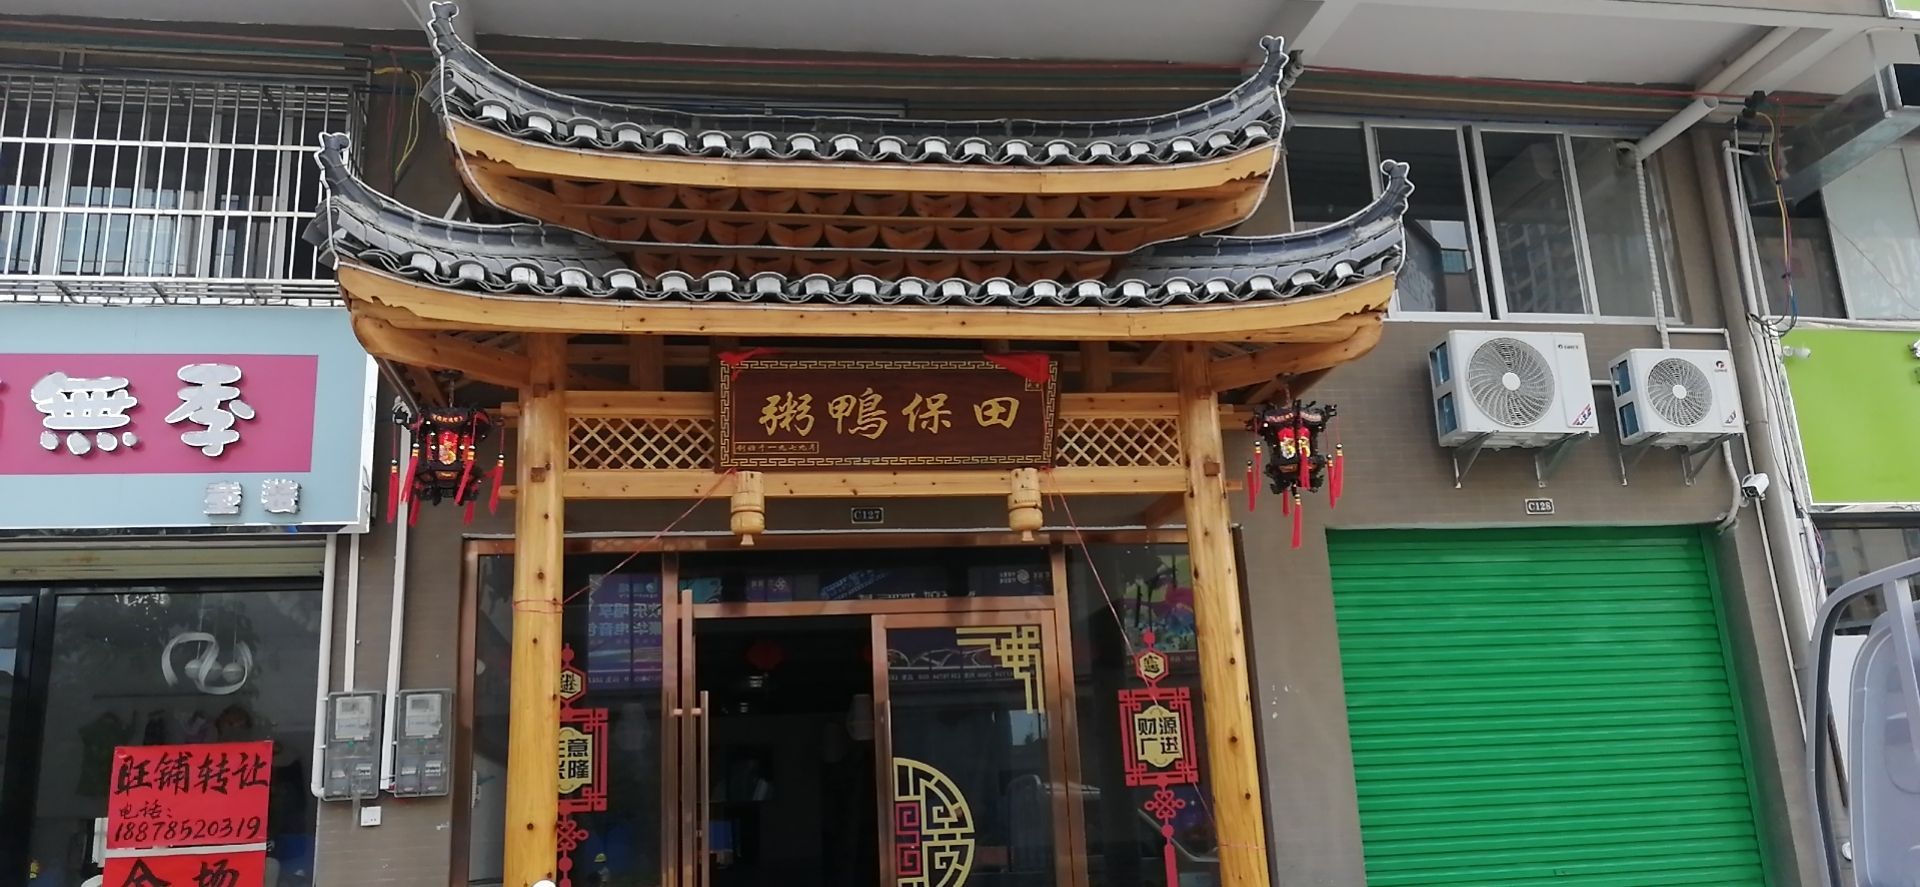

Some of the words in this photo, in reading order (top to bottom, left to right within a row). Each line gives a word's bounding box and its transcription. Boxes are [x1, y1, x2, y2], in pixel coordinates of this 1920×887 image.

[854, 510, 881, 520] C127
[1528, 501, 1552, 511] C128
[1137, 716, 1178, 735] 财源
[114, 751, 269, 796] 旺铺转让
[114, 816, 261, 842] 18878520319
